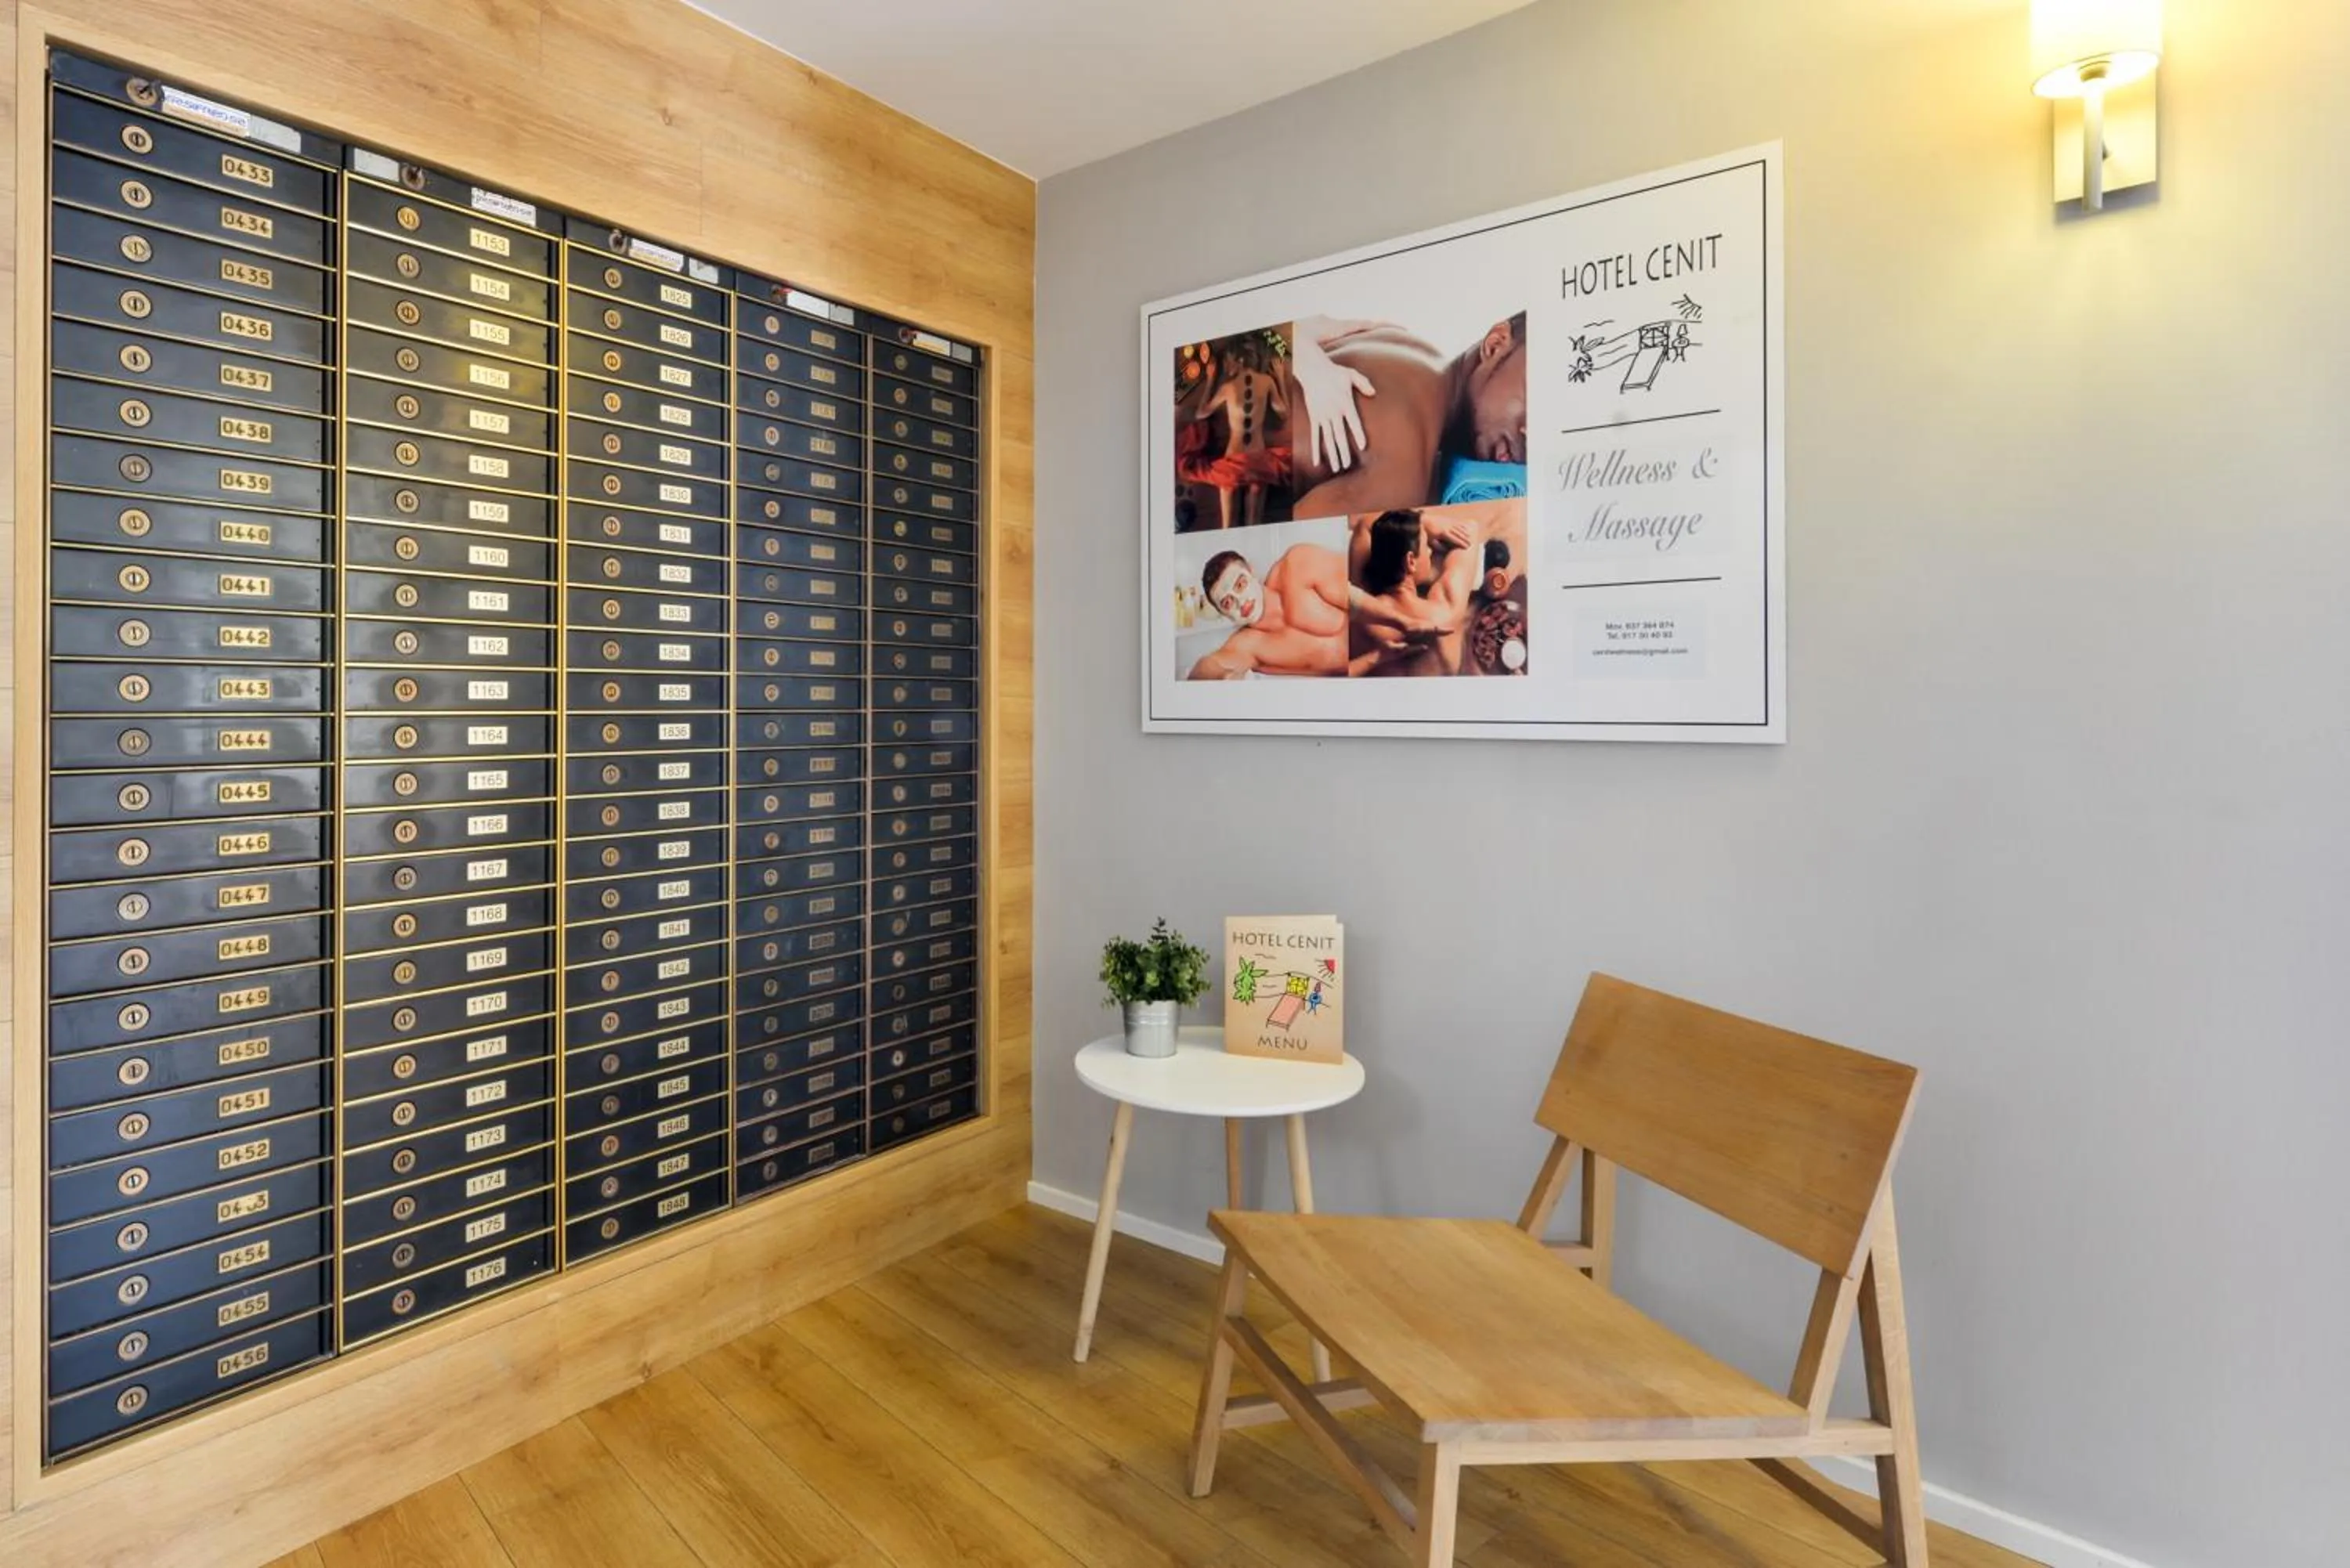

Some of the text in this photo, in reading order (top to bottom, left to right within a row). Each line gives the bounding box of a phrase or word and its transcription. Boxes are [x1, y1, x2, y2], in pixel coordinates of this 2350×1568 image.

[224, 158, 270, 184] 0433
[224, 211, 269, 235] 0434
[475, 231, 506, 251] 1153
[224, 263, 269, 285] 0435
[1562, 234, 1723, 299] HOTEL CENIT
[475, 276, 506, 296] 1154
[223, 316, 269, 337] 0436
[474, 322, 506, 341] 1155
[223, 368, 269, 388] 0437
[474, 367, 506, 385] 1156
[222, 421, 269, 439] 0438
[474, 413, 505, 429] 1157
[473, 457, 505, 474] 1158
[1558, 446, 1719, 491] Wellness &
[223, 473, 268, 491] 0439
[473, 503, 505, 519] 1159
[222, 525, 267, 543] 0440
[1567, 500, 1703, 551] Massage
[473, 548, 504, 564] 1160
[222, 578, 267, 594] 0441
[473, 594, 504, 608] 1161
[222, 630, 267, 645] 0442
[472, 639, 504, 652] 1162
[222, 683, 267, 697] 0443
[472, 684, 504, 696] 1163
[222, 734, 267, 749] 0444
[472, 729, 504, 742] 1164
[472, 773, 504, 787] 1165
[222, 786, 267, 800] 0445
[472, 817, 504, 833] 1166
[221, 836, 266, 853] 0446
[472, 862, 504, 878] 1167
[221, 888, 266, 905] 0447
[471, 906, 503, 923] 1168
[221, 938, 266, 957] 0448
[1232, 932, 1335, 949] HOTEL CENIT
[471, 950, 503, 969] 1169
[221, 990, 266, 1010] 0449
[471, 995, 503, 1013] 1170
[221, 1040, 266, 1062] 0450
[471, 1039, 503, 1059] 1171
[1257, 1035, 1307, 1050] MENU
[471, 1083, 502, 1104] 1172
[221, 1092, 267, 1115] 0451
[471, 1128, 501, 1149] 1173
[221, 1143, 266, 1167] 0452
[471, 1172, 502, 1194] 1174
[470, 1216, 501, 1240] 1175
[221, 1244, 266, 1270] 0454
[471, 1260, 502, 1284] 1176
[221, 1295, 266, 1324] 0455
[220, 1346, 266, 1376] 0456
